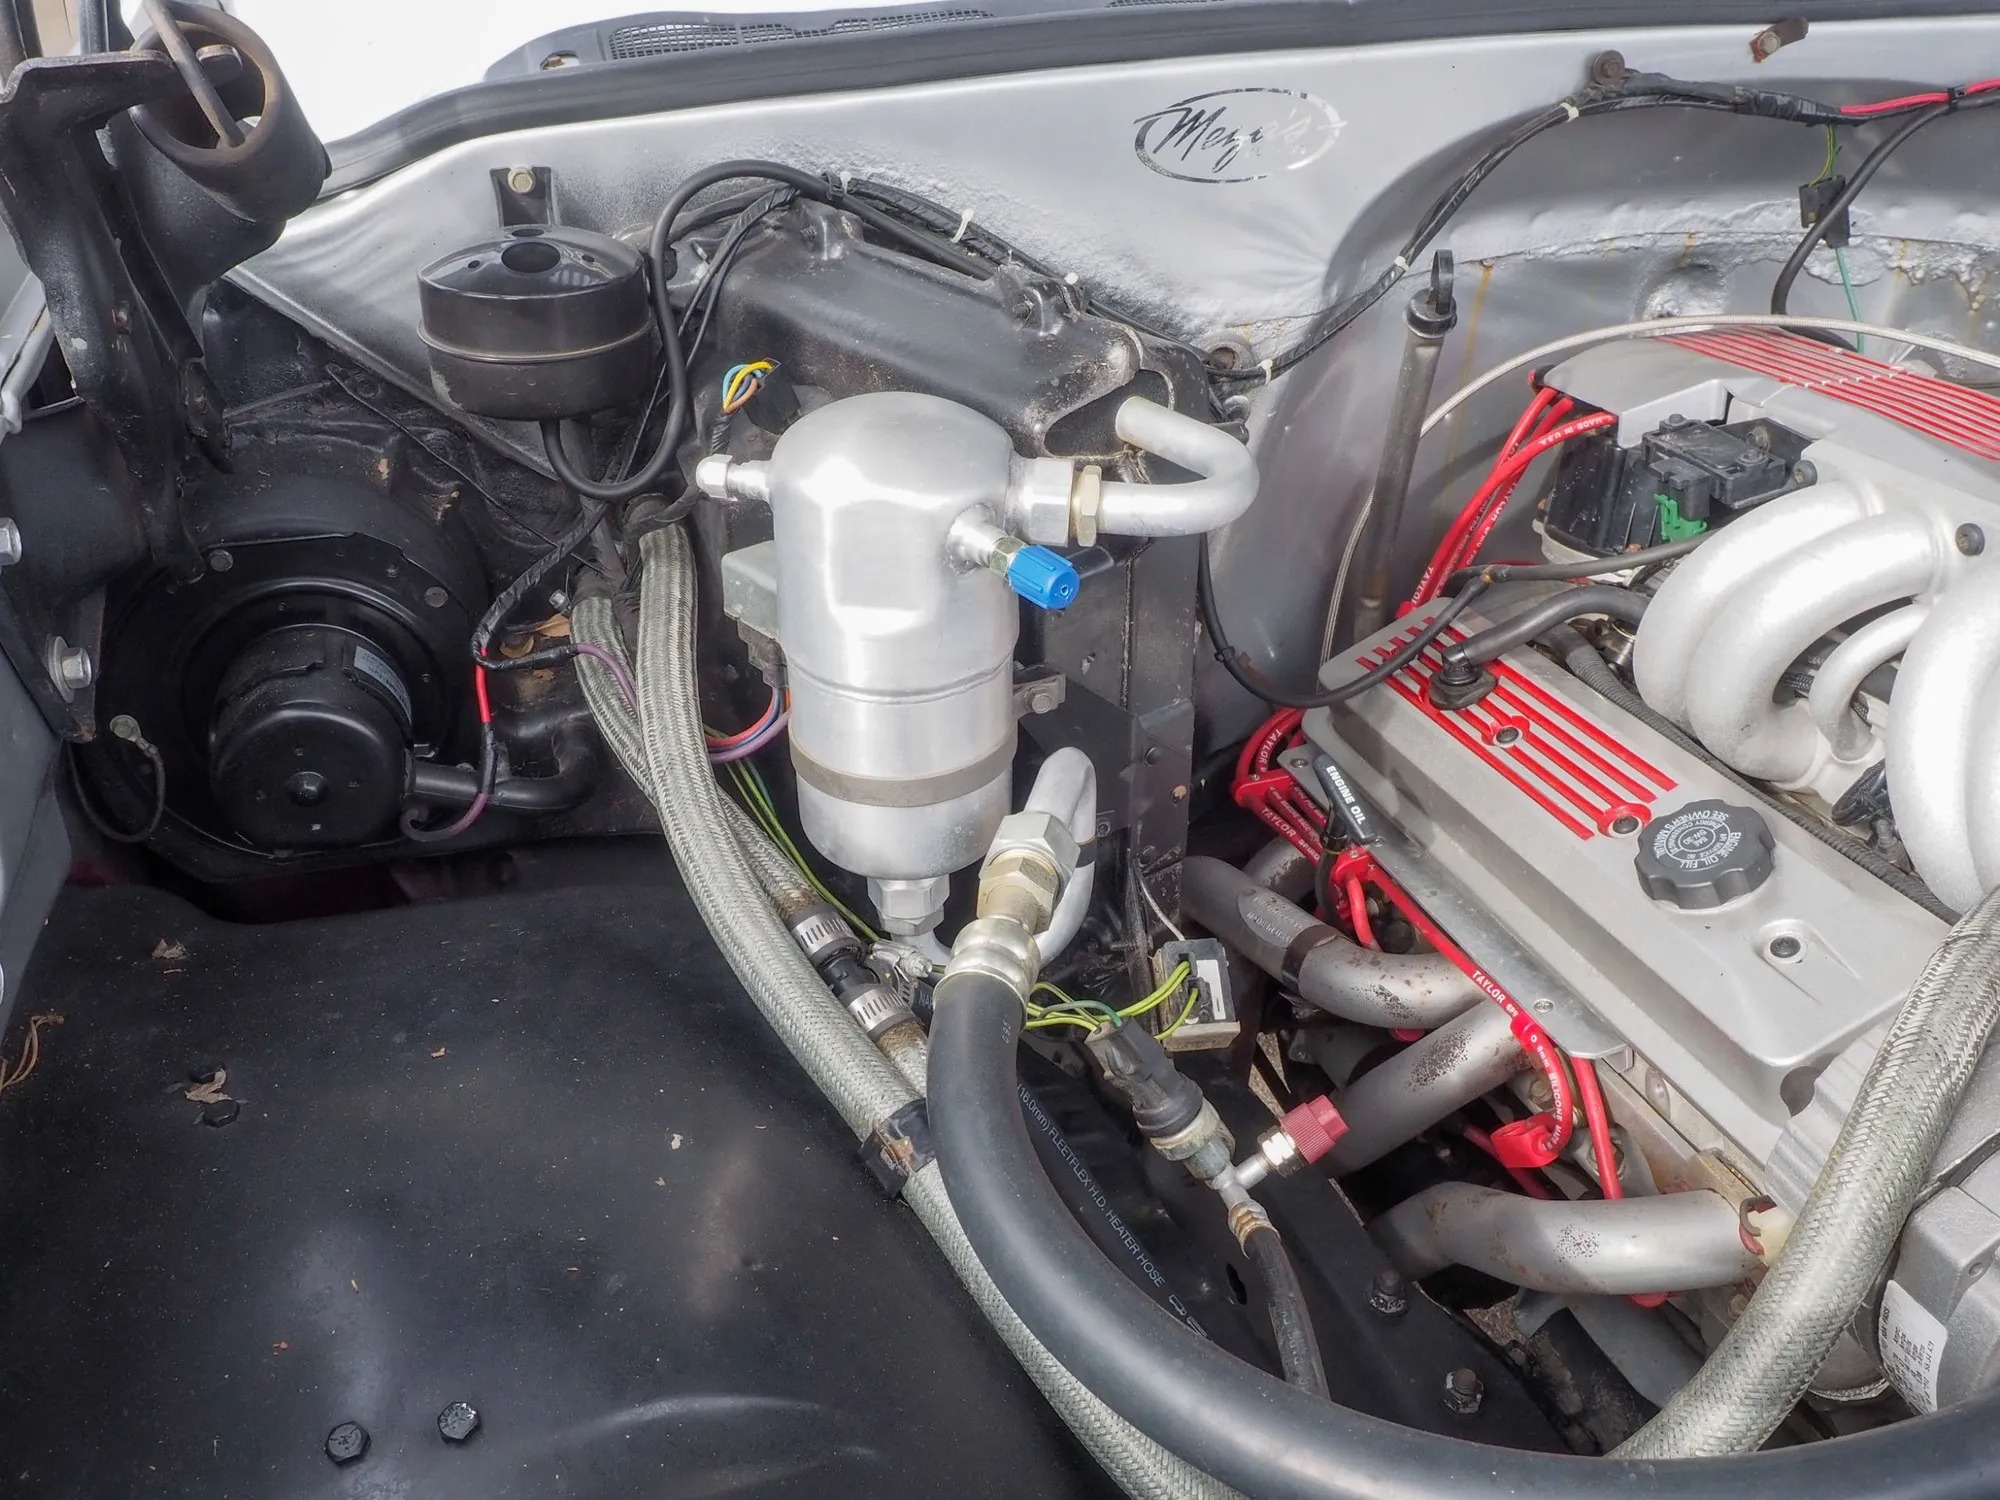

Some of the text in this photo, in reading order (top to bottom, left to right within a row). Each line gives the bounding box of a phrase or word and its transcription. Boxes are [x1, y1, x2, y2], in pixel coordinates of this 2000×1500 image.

[1564, 426, 1574, 436] IN
[1577, 418, 1604, 431] MADE
[1256, 728, 1282, 766] TAYLOR
[1326, 766, 1367, 825] ENGINE OIL
[1260, 808, 1296, 837] TAYLOR
[1654, 810, 1730, 858] SEE OWNER'S MANUAL
[1680, 832, 1742, 869] ENGINE OIL FILL
[1472, 970, 1506, 1004] TAYLOR
[1536, 1045, 1551, 1068] 8mm
[1548, 1072, 1564, 1122] SILICONE
[1049, 1124, 1092, 1188] FLEETFLEX
[1088, 1186, 1107, 1210] H.D.
[1106, 1210, 1140, 1256] HEATER
[1136, 1254, 1166, 1288] HOSE
